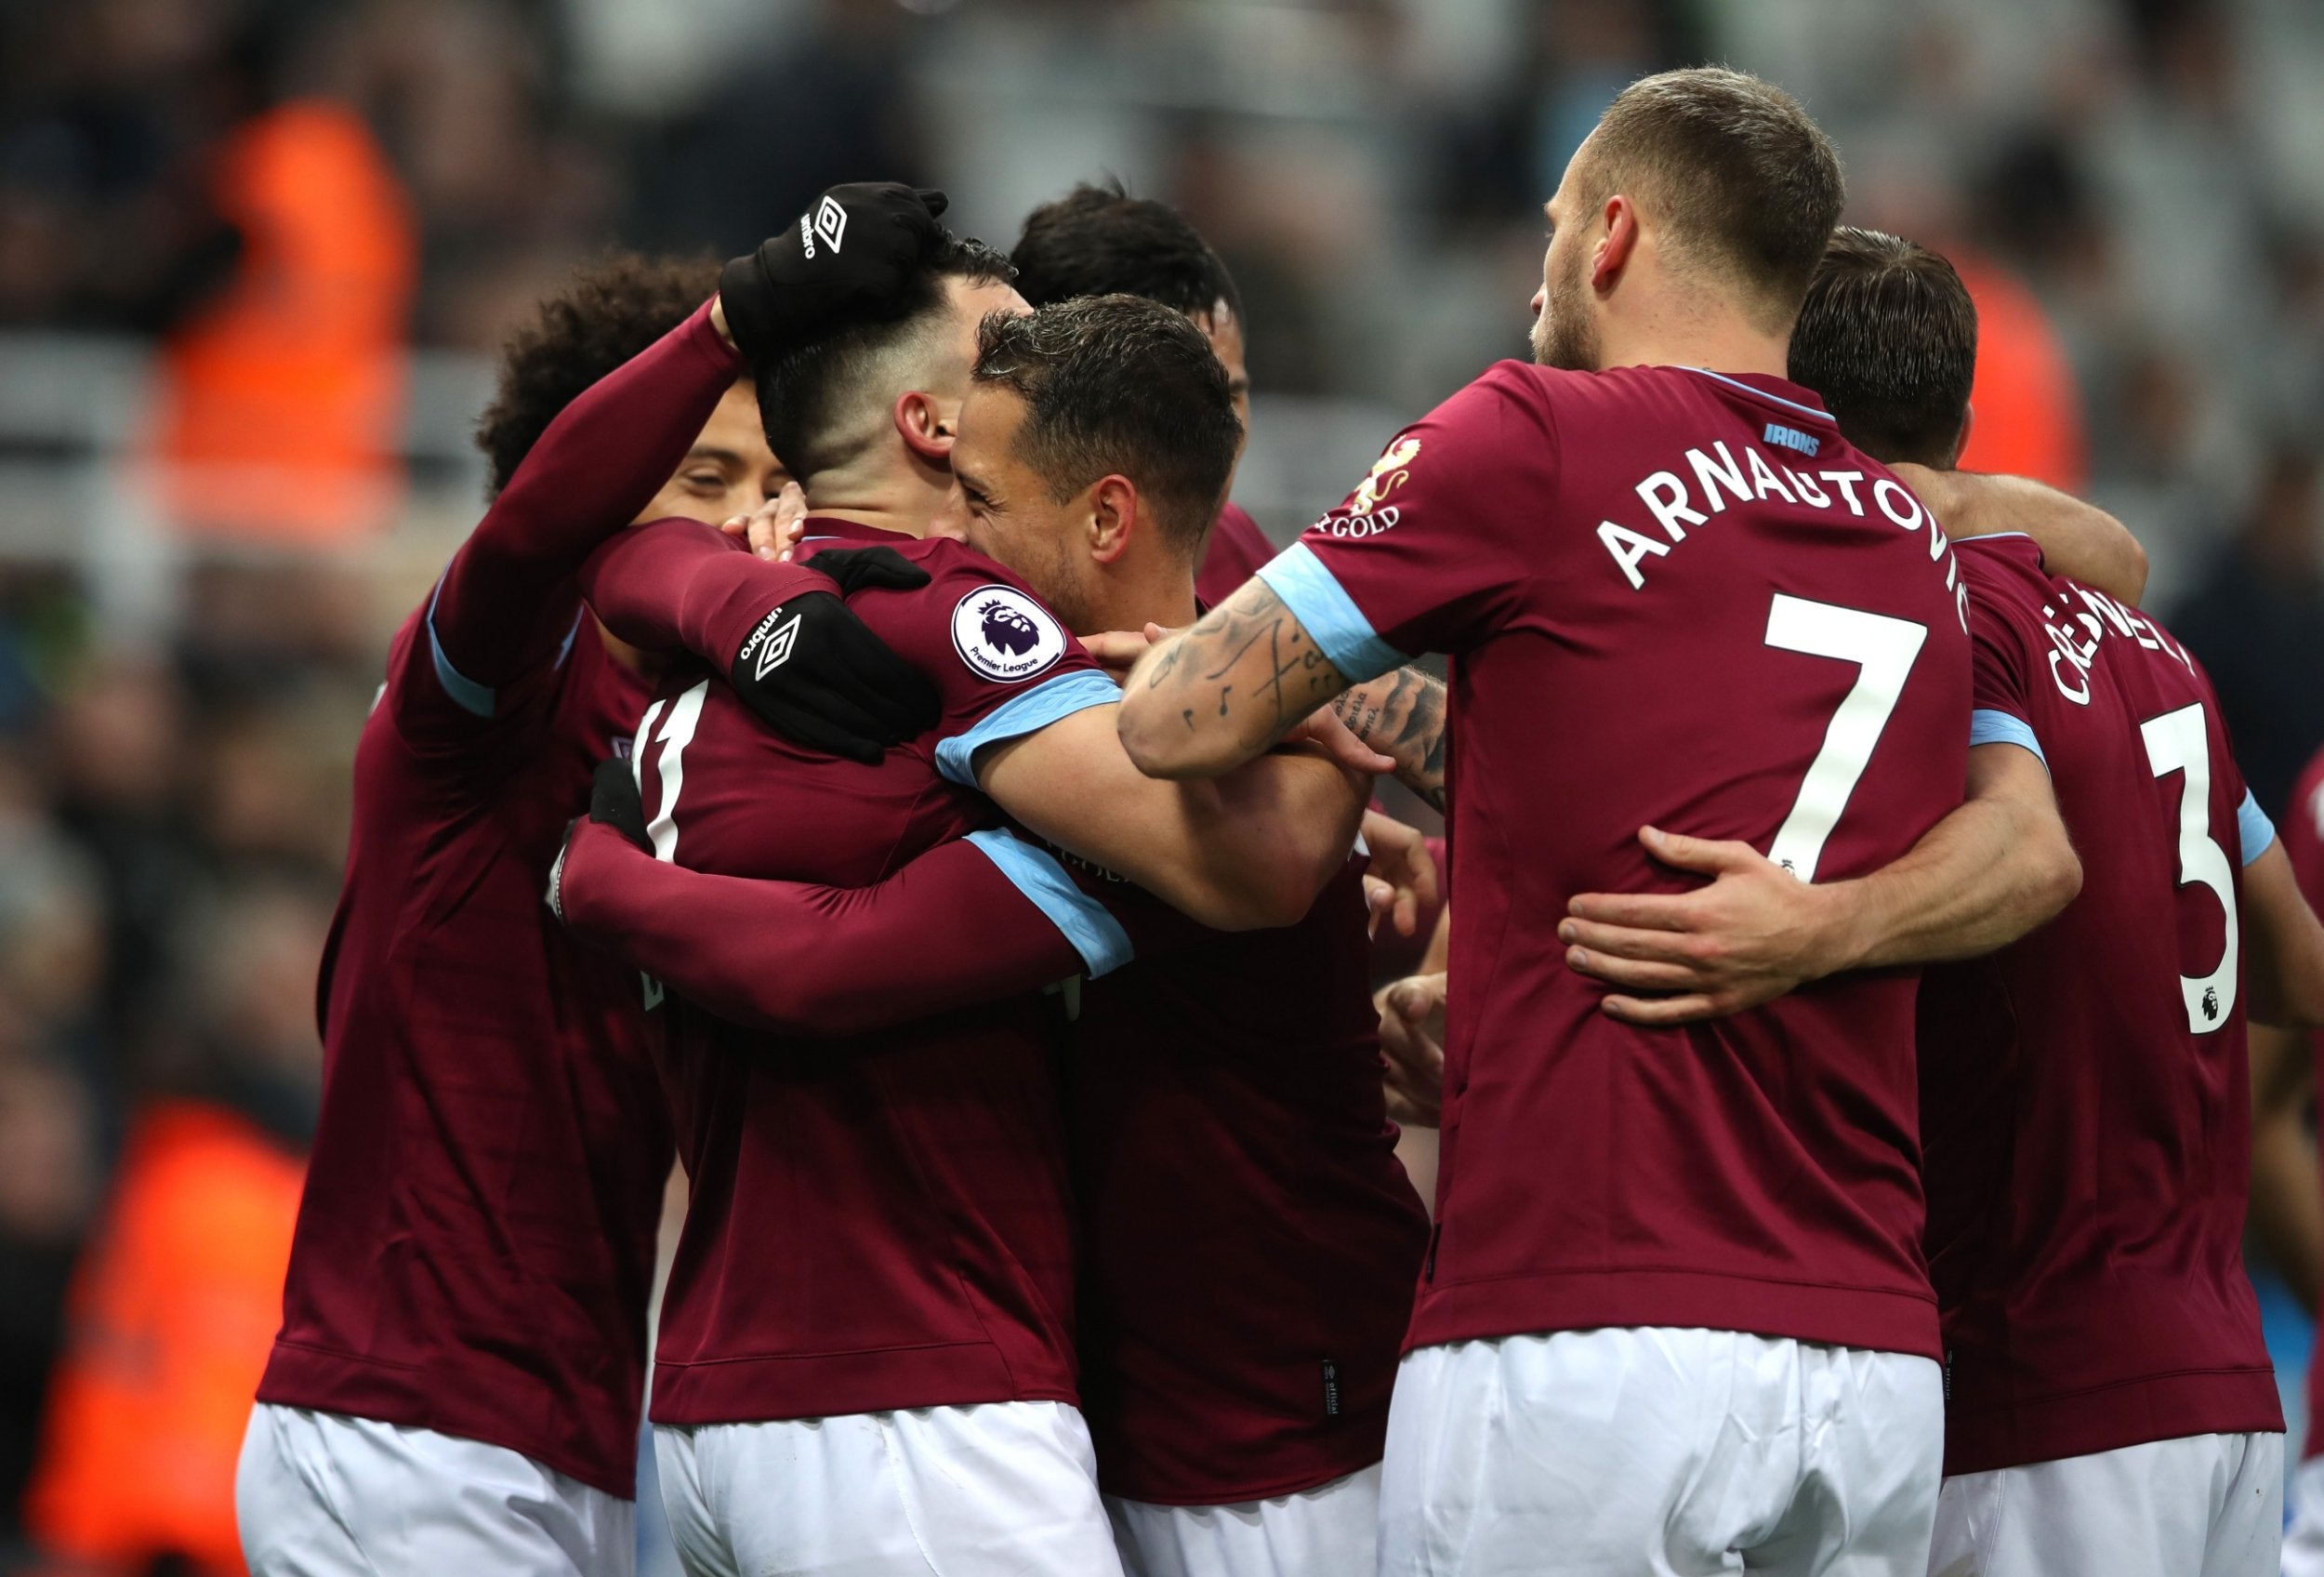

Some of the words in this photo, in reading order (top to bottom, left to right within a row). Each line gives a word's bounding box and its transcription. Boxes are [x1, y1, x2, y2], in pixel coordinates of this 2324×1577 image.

[800, 213, 815, 259] umbro
[1763, 423, 1820, 457] IRONS
[1332, 506, 1400, 538] GOLD
[741, 606, 783, 660] umbro
[970, 645, 1001, 671] Premier
[1003, 657, 1038, 672] League
[1764, 592, 1929, 884] 7
[2139, 701, 2238, 1035] 3
